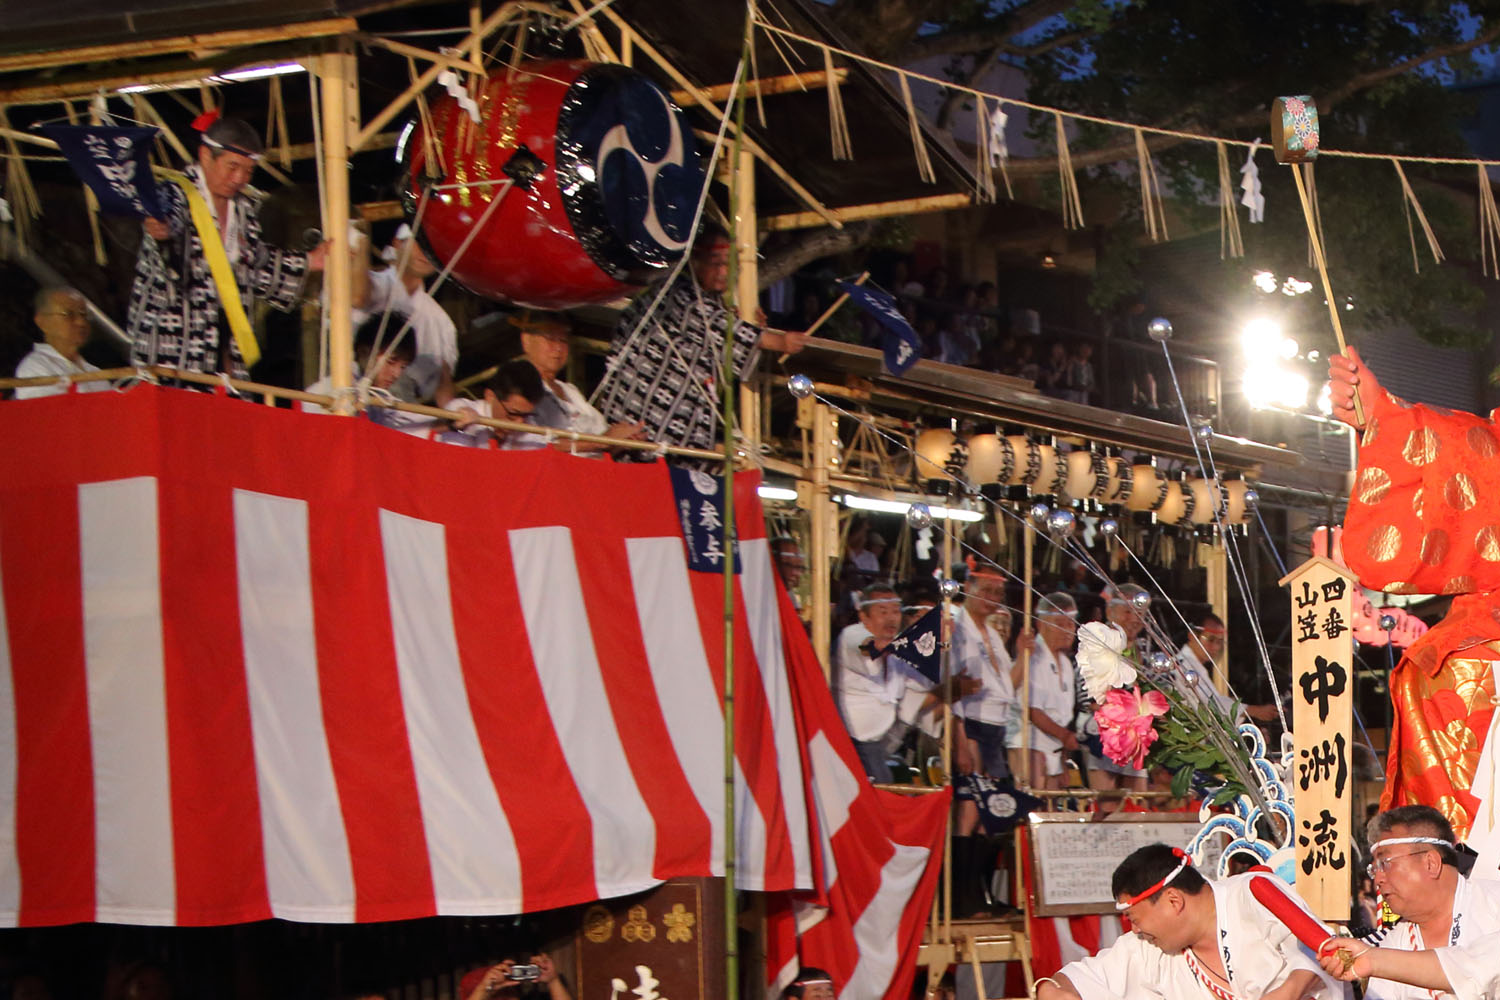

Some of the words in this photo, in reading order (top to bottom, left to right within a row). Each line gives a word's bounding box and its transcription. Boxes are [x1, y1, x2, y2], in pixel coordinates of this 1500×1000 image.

[1295, 582, 1320, 643] 山笠
[1321, 577, 1349, 640] 四番
[1299, 655, 1347, 877] 中洲流
